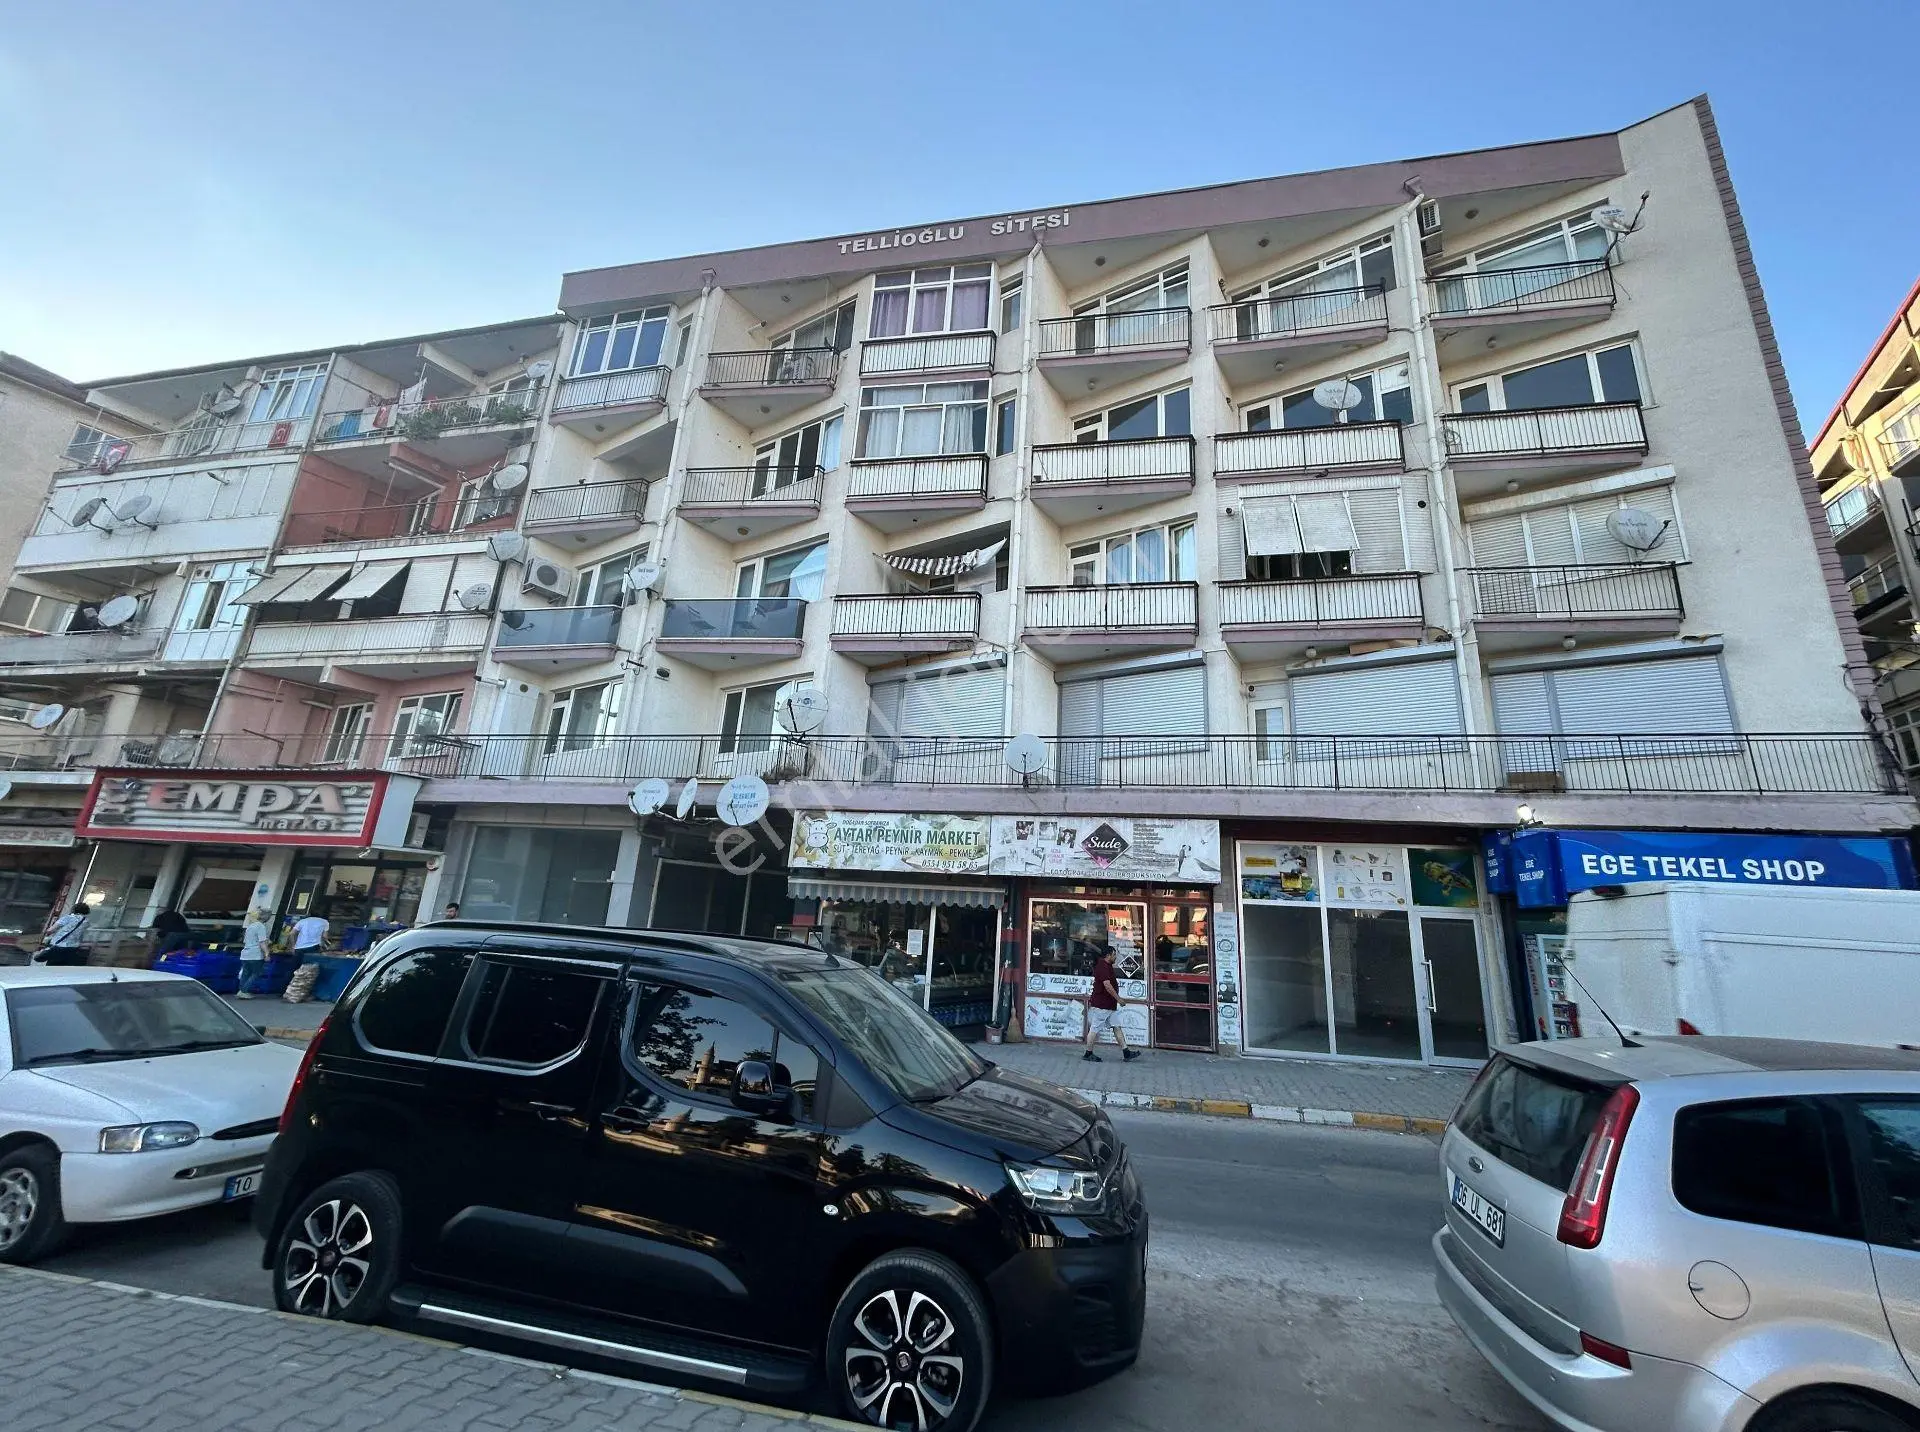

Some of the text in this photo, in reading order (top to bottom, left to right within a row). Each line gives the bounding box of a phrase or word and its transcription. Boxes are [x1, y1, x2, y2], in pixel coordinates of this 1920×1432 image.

[837, 209, 1070, 254] TELLİOĞLU SİTESİ
[257, 816, 344, 832] market
[834, 825, 981, 846] AYTAR PEYNİR MARKET
[1087, 835, 1122, 851] Sude
[949, 848, 978, 858] PEKMEZ
[1524, 859, 1535, 869] EGE
[1581, 853, 1826, 882] EGE TEKEL SHOP
[235, 1176, 253, 1194] 10
[1470, 1192, 1482, 1222] UL
[1486, 1206, 1504, 1238] 681
